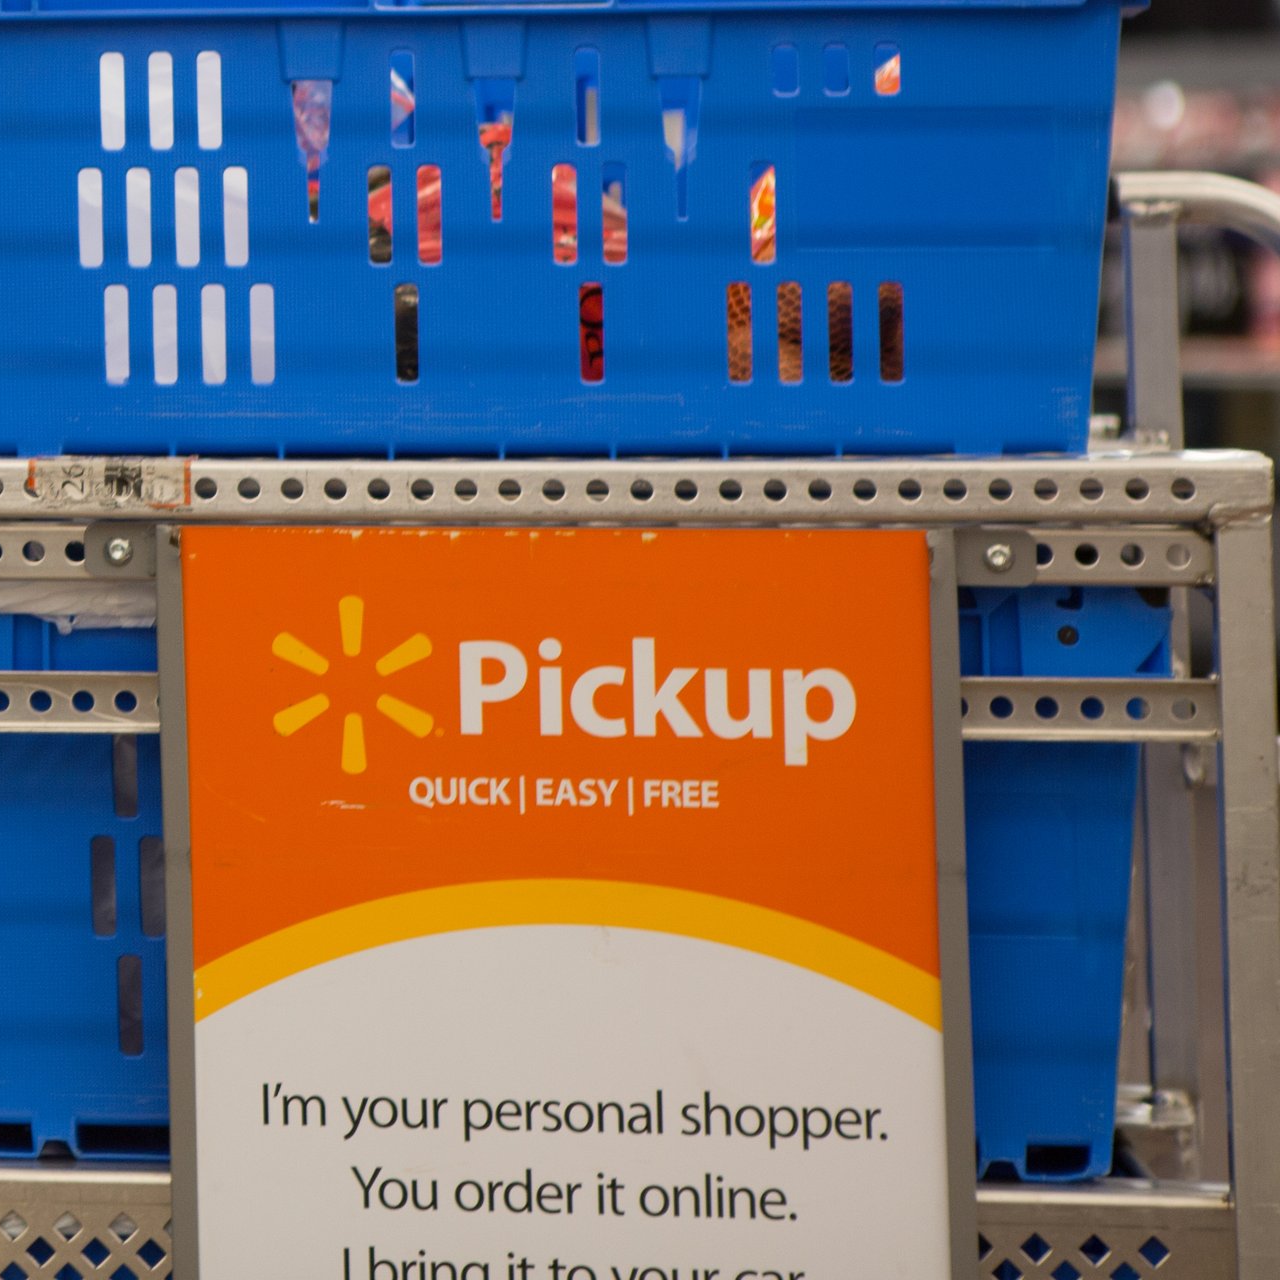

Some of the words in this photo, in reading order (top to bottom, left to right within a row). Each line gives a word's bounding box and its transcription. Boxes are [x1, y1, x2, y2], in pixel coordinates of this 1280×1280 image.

[459, 636, 857, 767] Pickup
[409, 775, 511, 809] QUICK
[536, 778, 619, 808] EASY
[643, 780, 720, 809] FREE
[341, 1093, 448, 1141] your
[462, 1090, 665, 1143] personal
[680, 1091, 890, 1151] shopper.
[351, 1166, 439, 1211] You
[453, 1168, 583, 1215] order
[597, 1172, 625, 1217] it
[638, 1173, 799, 1223] online.
[507, 1251, 536, 1280] it
